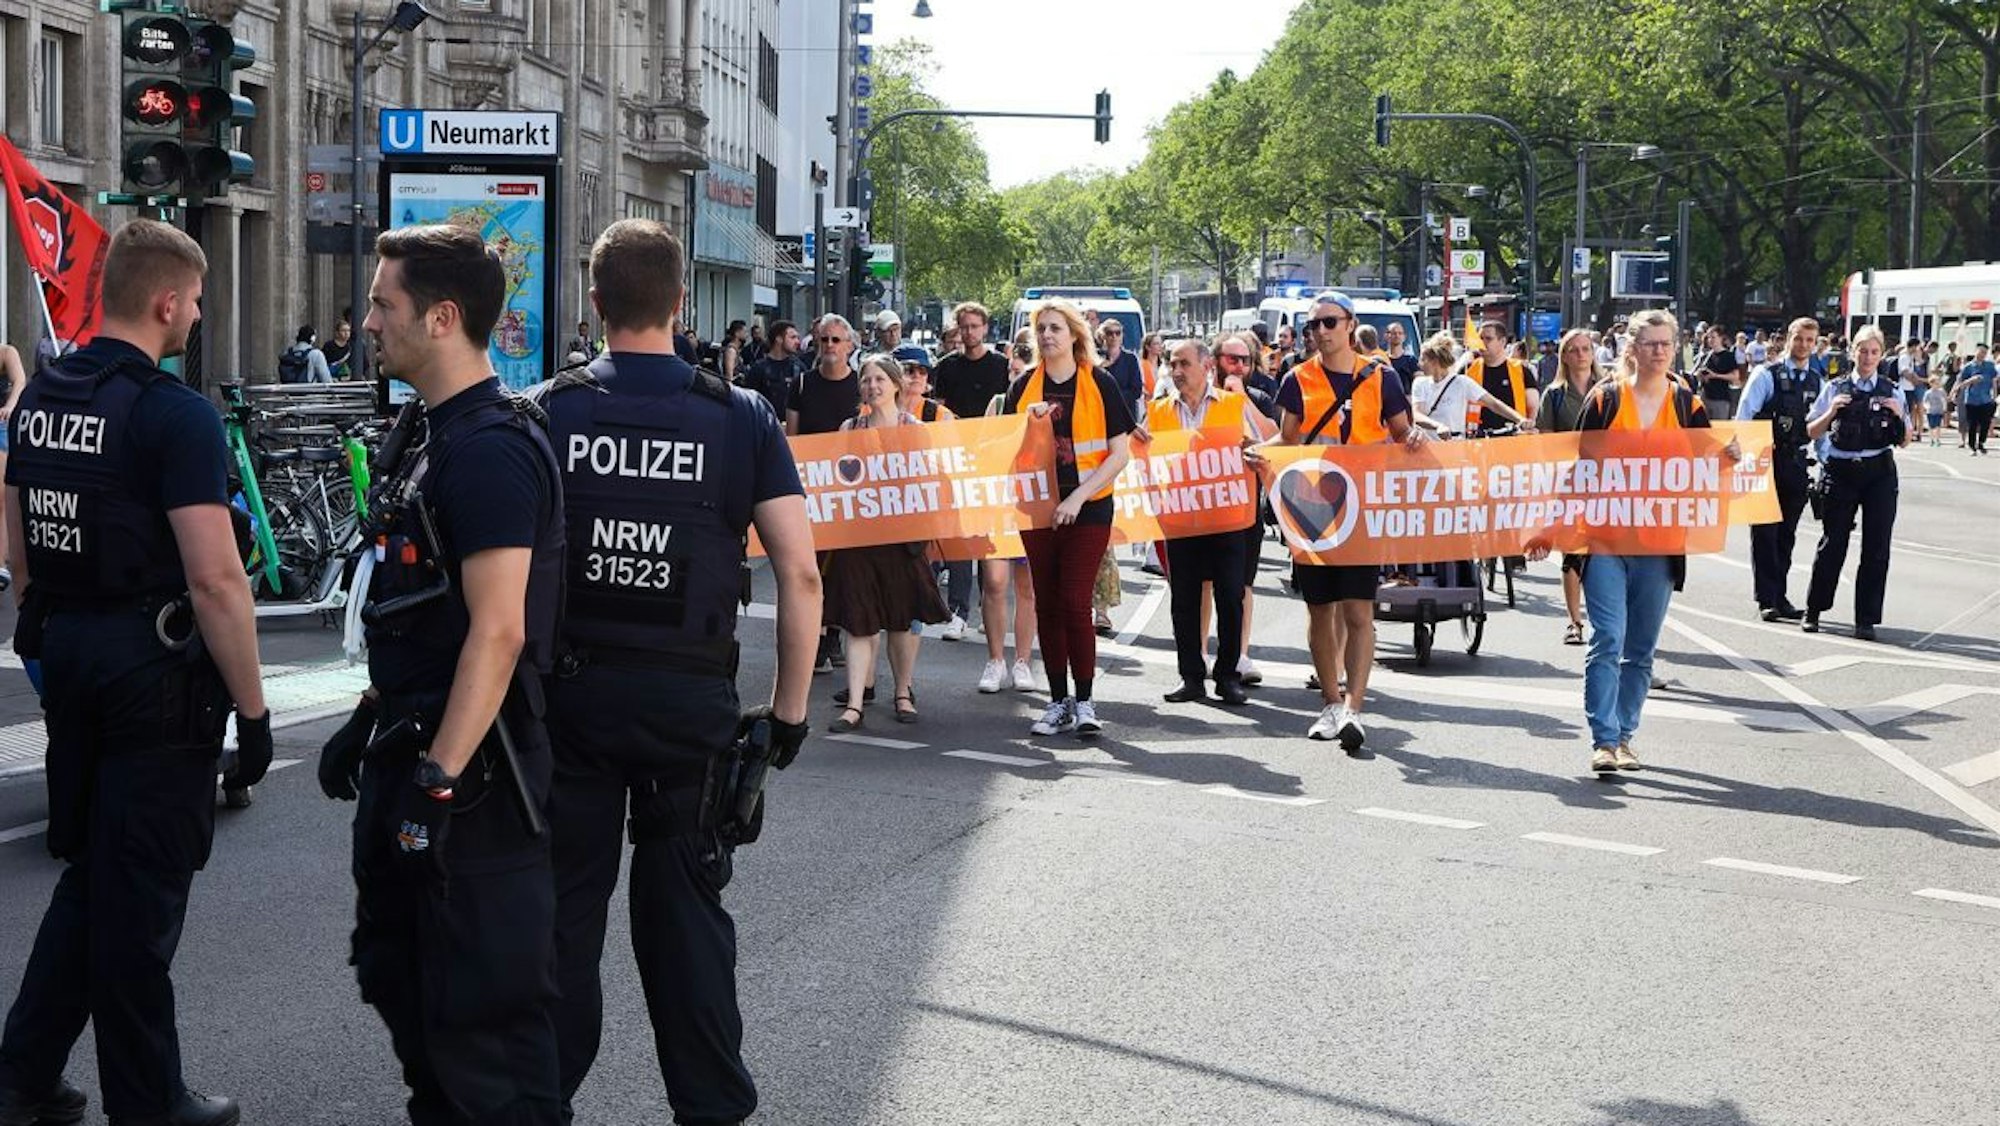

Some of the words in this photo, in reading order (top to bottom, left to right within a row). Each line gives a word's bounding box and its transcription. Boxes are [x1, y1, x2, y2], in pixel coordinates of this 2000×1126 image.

[388, 115, 416, 149] U
[431, 120, 550, 145] Neumarkt
[1456, 226, 1466, 238] B
[17, 409, 106, 454] POLIZEI
[567, 433, 705, 482] POLIZEI
[1114, 446, 1244, 490] ERATION
[806, 481, 940, 523] AFTSRAT
[951, 470, 1050, 509] JETZT!
[1113, 479, 1249, 519] PPUNKTEN
[1364, 466, 1480, 504] LETZTE
[1488, 457, 1719, 499] GENERATION
[29, 487, 78, 519] NRW
[1364, 508, 1425, 538] VOR
[1433, 504, 1488, 536] DEN
[1495, 497, 1719, 531] KIPPPUNKTEN
[29, 519, 82, 552] 31521
[592, 517, 673, 554] NRW
[585, 553, 671, 589] 31523
